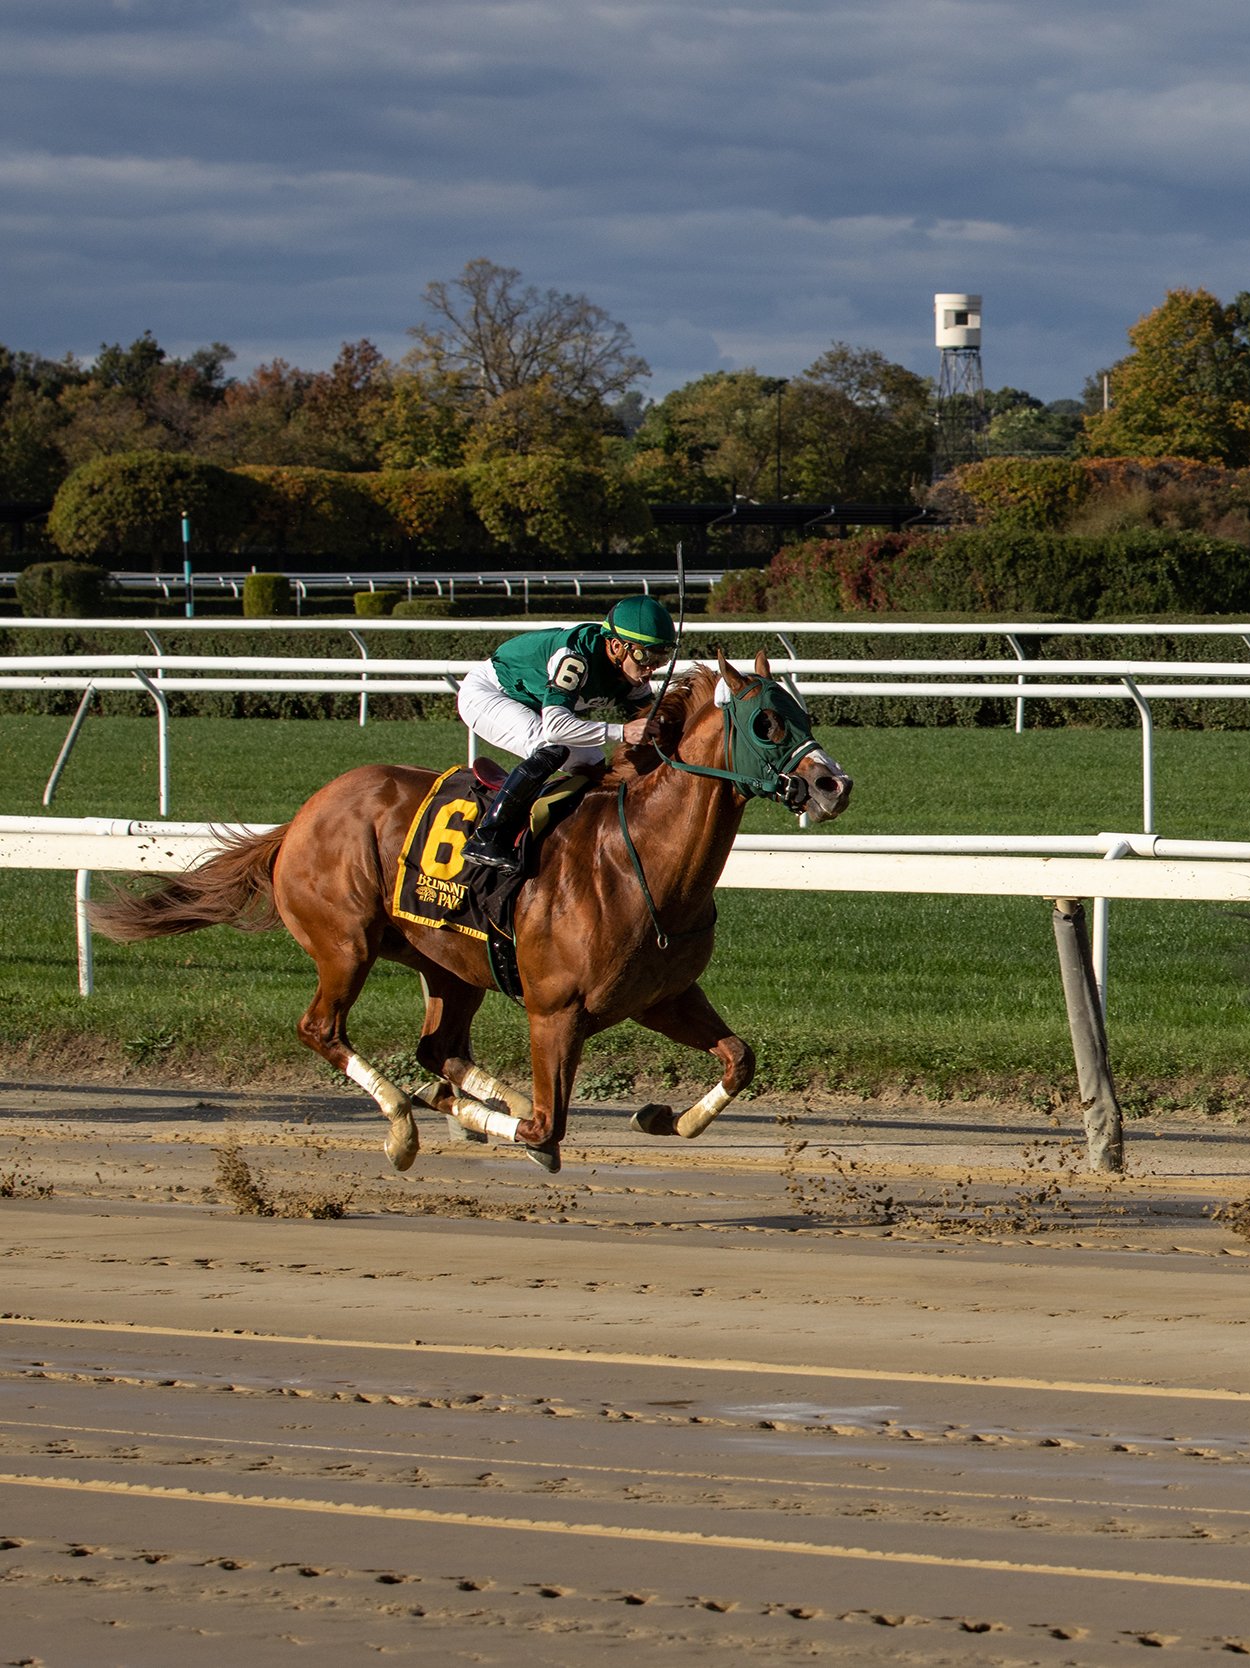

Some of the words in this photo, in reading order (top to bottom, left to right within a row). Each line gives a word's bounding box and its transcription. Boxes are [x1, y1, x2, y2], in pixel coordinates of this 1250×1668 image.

[555, 656, 586, 692] 6
[420, 798, 479, 881] 6
[416, 873, 469, 899] BELMONT
